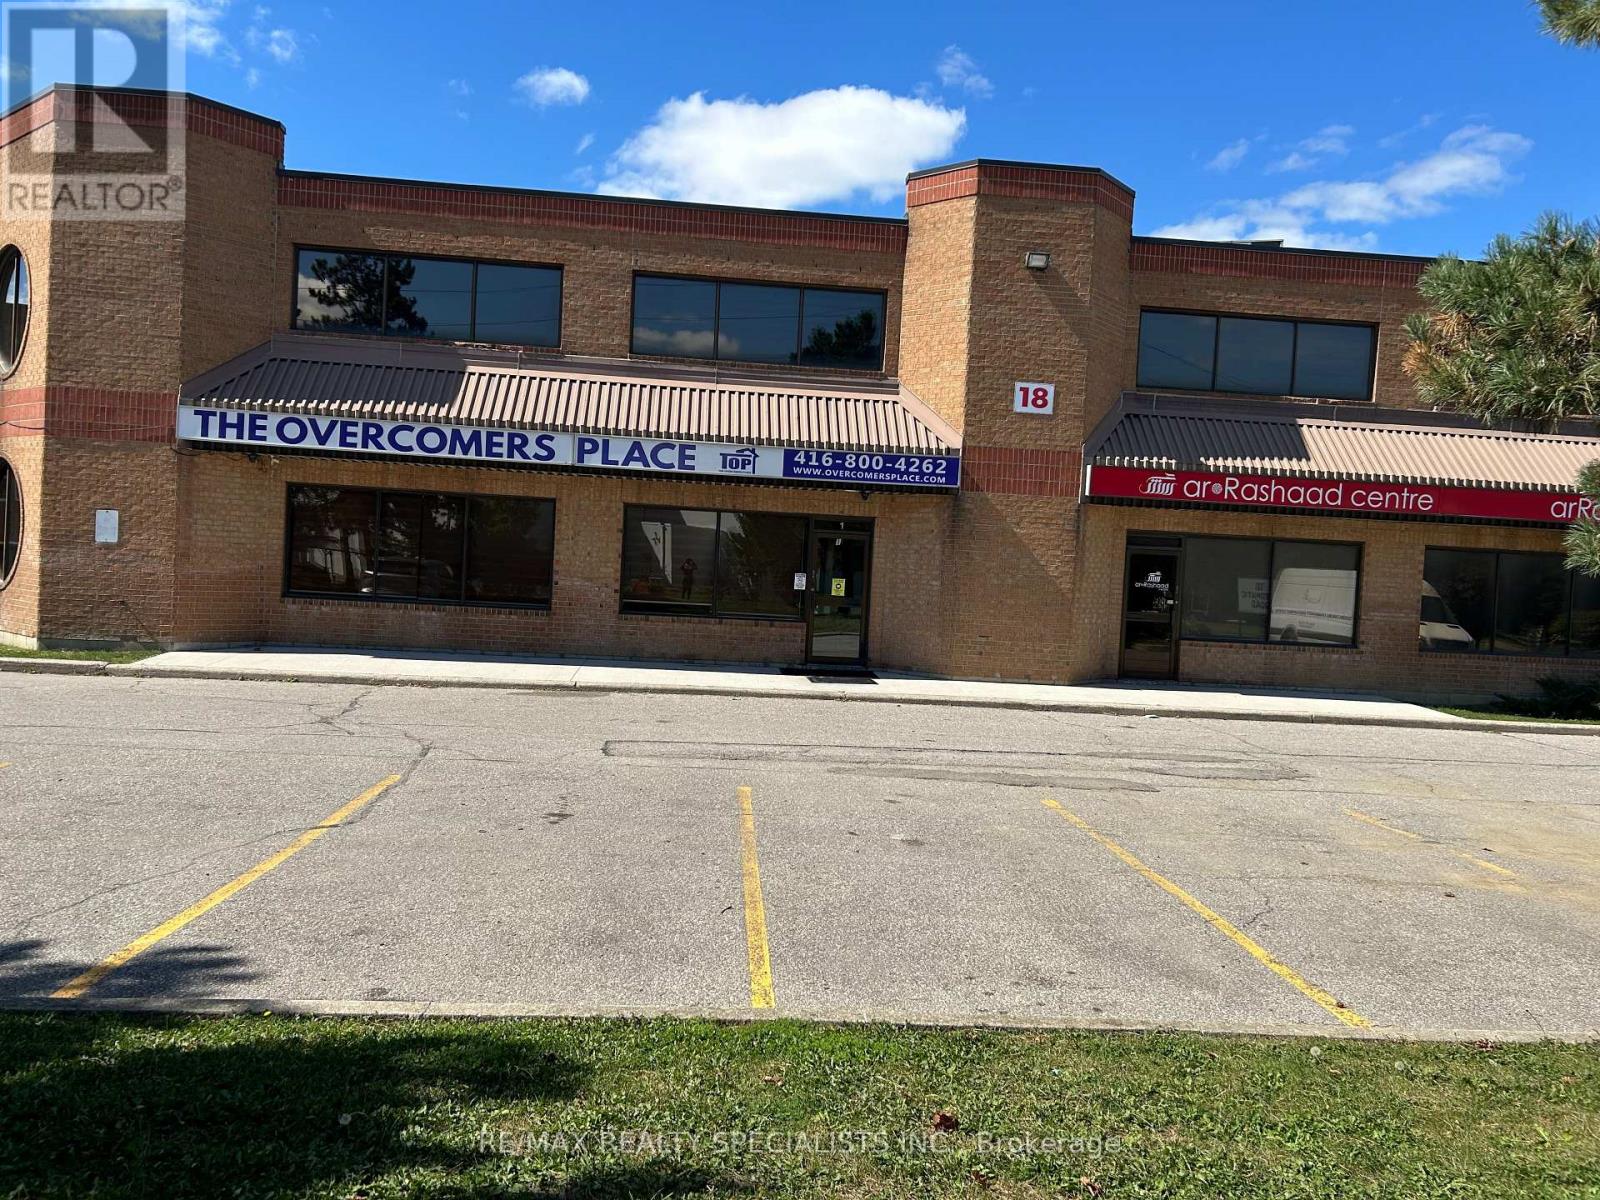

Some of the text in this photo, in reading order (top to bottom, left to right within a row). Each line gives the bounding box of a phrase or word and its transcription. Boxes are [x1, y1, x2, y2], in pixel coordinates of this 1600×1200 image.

[1019, 386, 1049, 409] 18
[193, 409, 556, 462] THE OVERCOMERS
[576, 437, 696, 471] PLACE
[719, 452, 753, 470] TOP
[793, 450, 947, 474] 416-800-4262
[793, 466, 946, 484] WWW.OVERCOMERSPLACE.COM
[1351, 487, 1434, 511] centre
